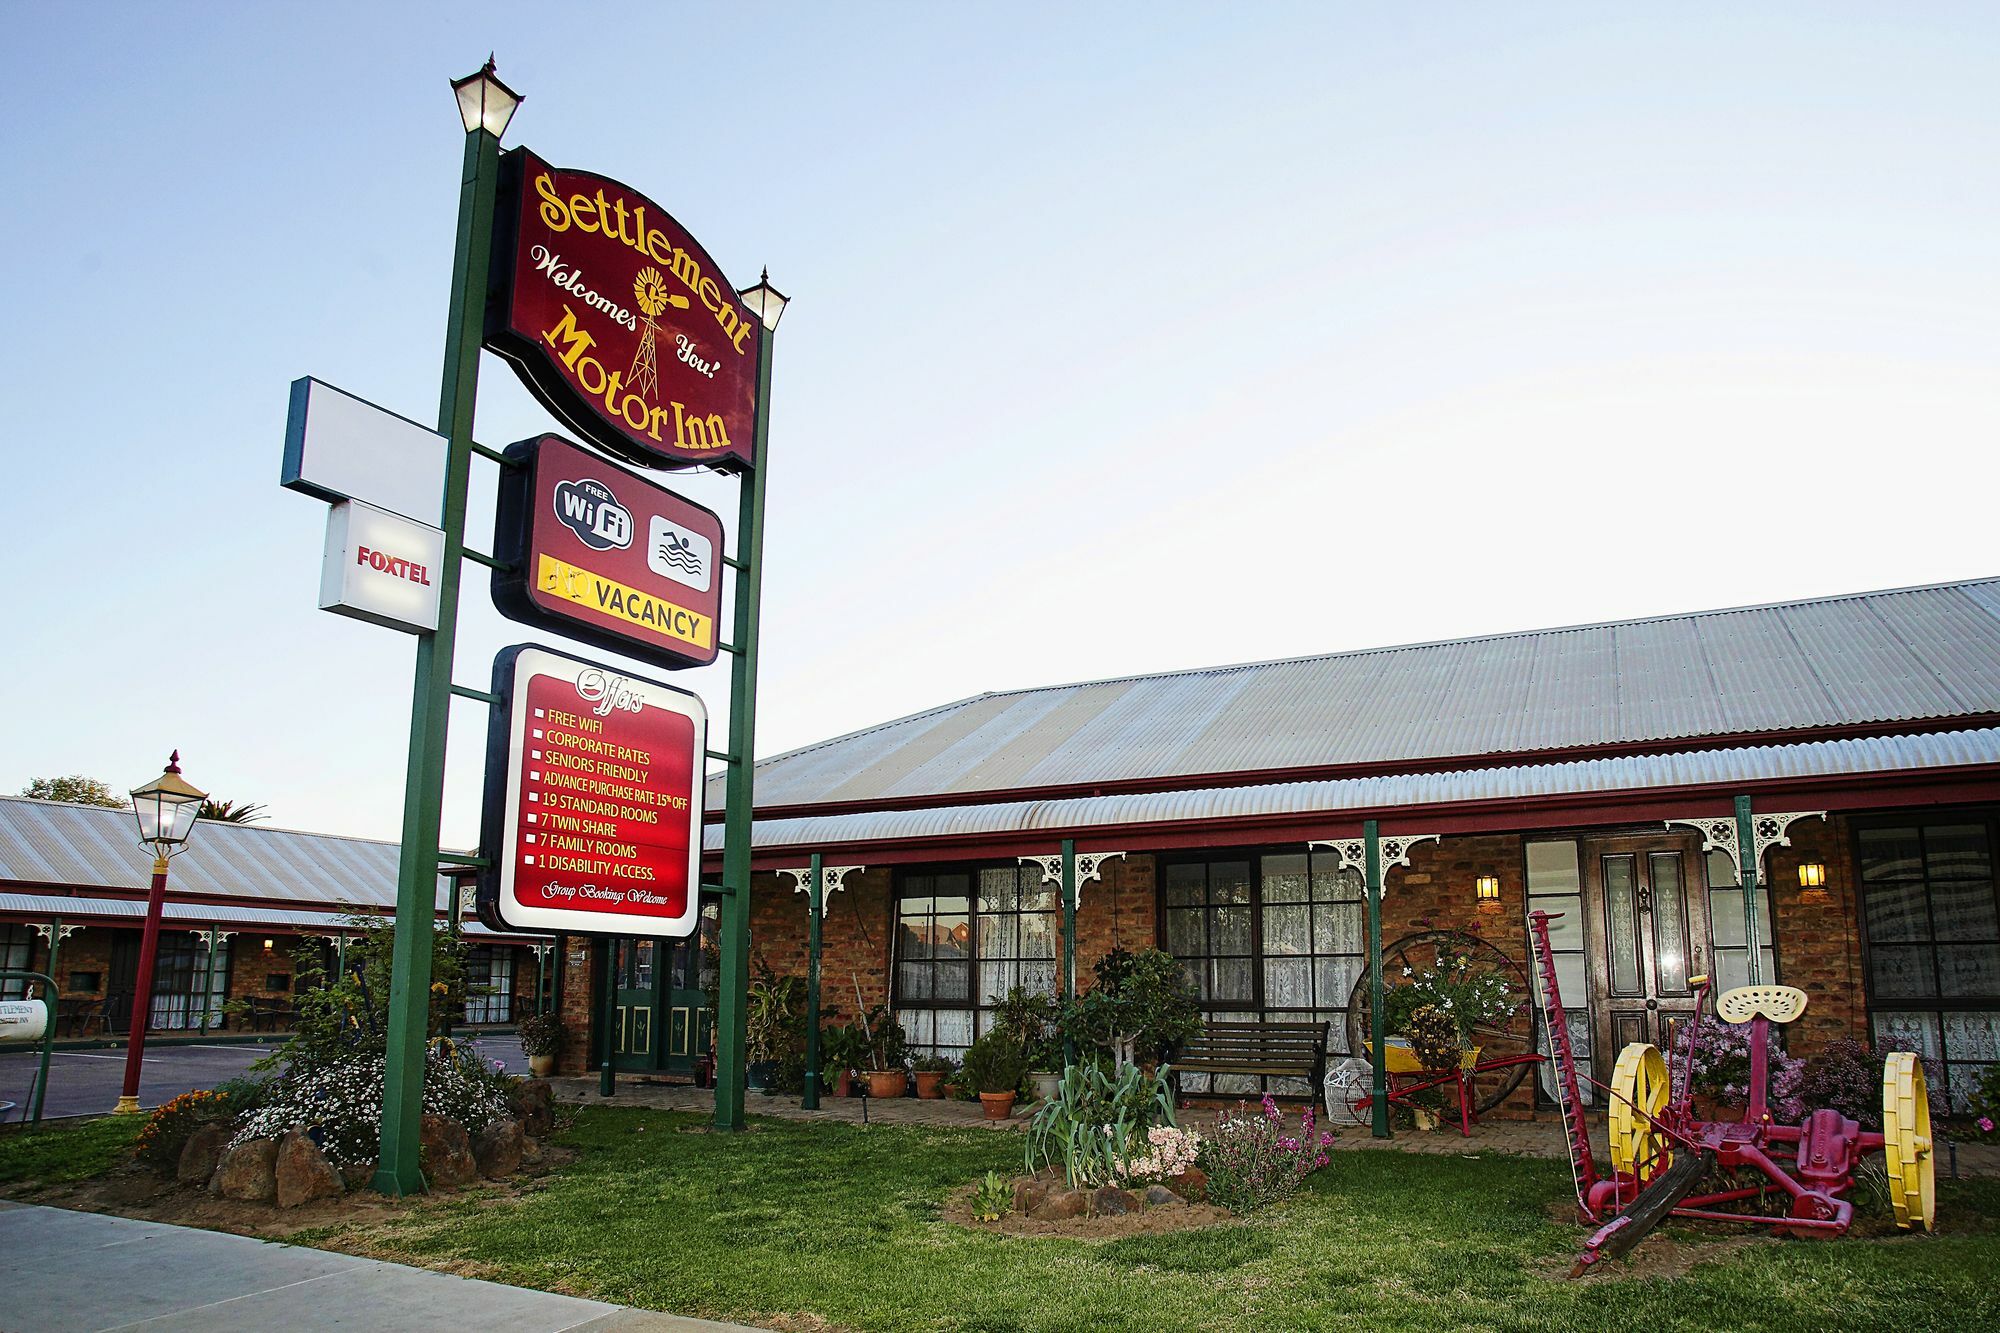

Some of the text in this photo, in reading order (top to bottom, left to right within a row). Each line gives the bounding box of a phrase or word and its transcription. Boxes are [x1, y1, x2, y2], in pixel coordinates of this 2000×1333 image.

[535, 172, 753, 356] Settlement
[530, 244, 721, 379] Welcomes You!
[541, 304, 731, 450] Motor Inn
[585, 483, 609, 501] FREE
[357, 545, 430, 586] FOXTEL
[595, 580, 700, 639] VACANCY
[576, 668, 645, 716] Offers
[548, 709, 603, 735] FREE WIFI
[546, 729, 650, 765] CORPORATE RATES
[545, 750, 649, 784] SENIORS FRIENDLY
[542, 792, 658, 824] 19 STANDARD ROOMS
[543, 771, 688, 811] ADVANCE PURCHASE RATE 15% OFF
[541, 812, 617, 838] 7 TWIN SHARE
[540, 832, 637, 859] 7 FAMILY ROOMS
[538, 854, 656, 881] 1 DISABILITY ACCESS.
[541, 880, 668, 905] Group Bookings Welcome
